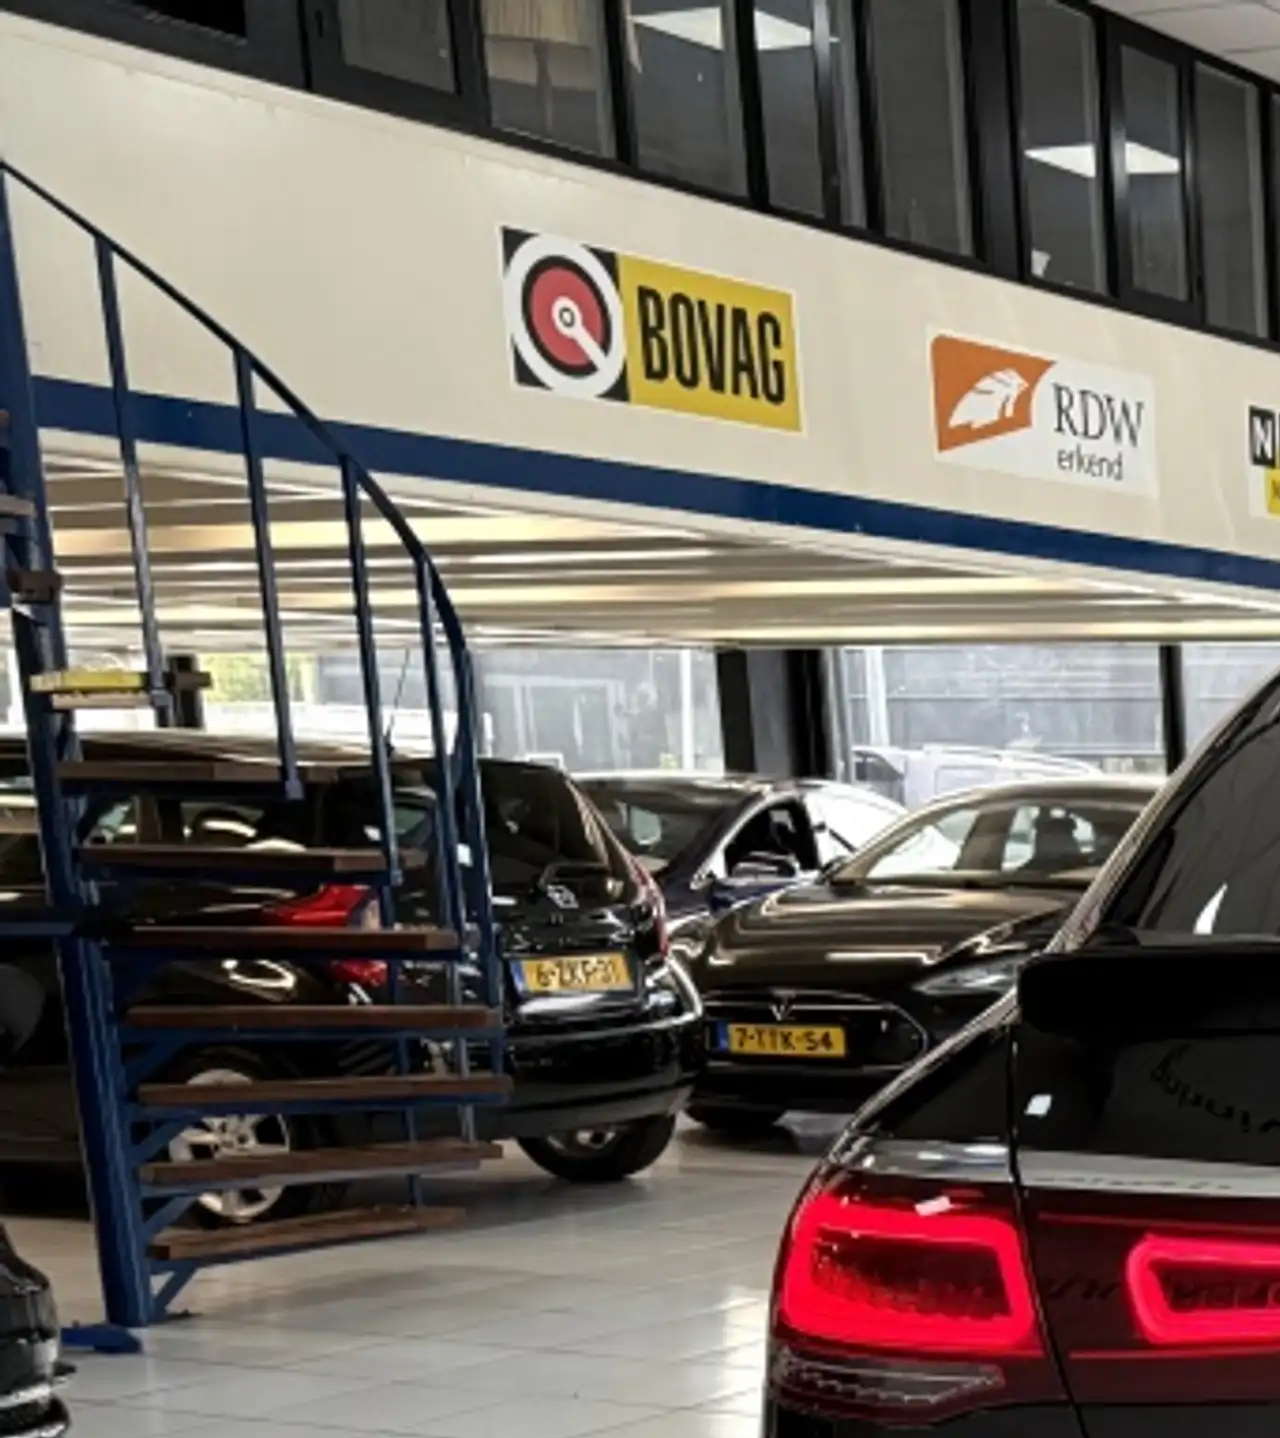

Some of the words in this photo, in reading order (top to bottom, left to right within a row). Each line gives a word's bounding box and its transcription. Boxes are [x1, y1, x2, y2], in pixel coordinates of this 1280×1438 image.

[637, 284, 786, 406] BOVAG
[1051, 382, 1144, 448] RDW
[1057, 444, 1123, 481] erkend
